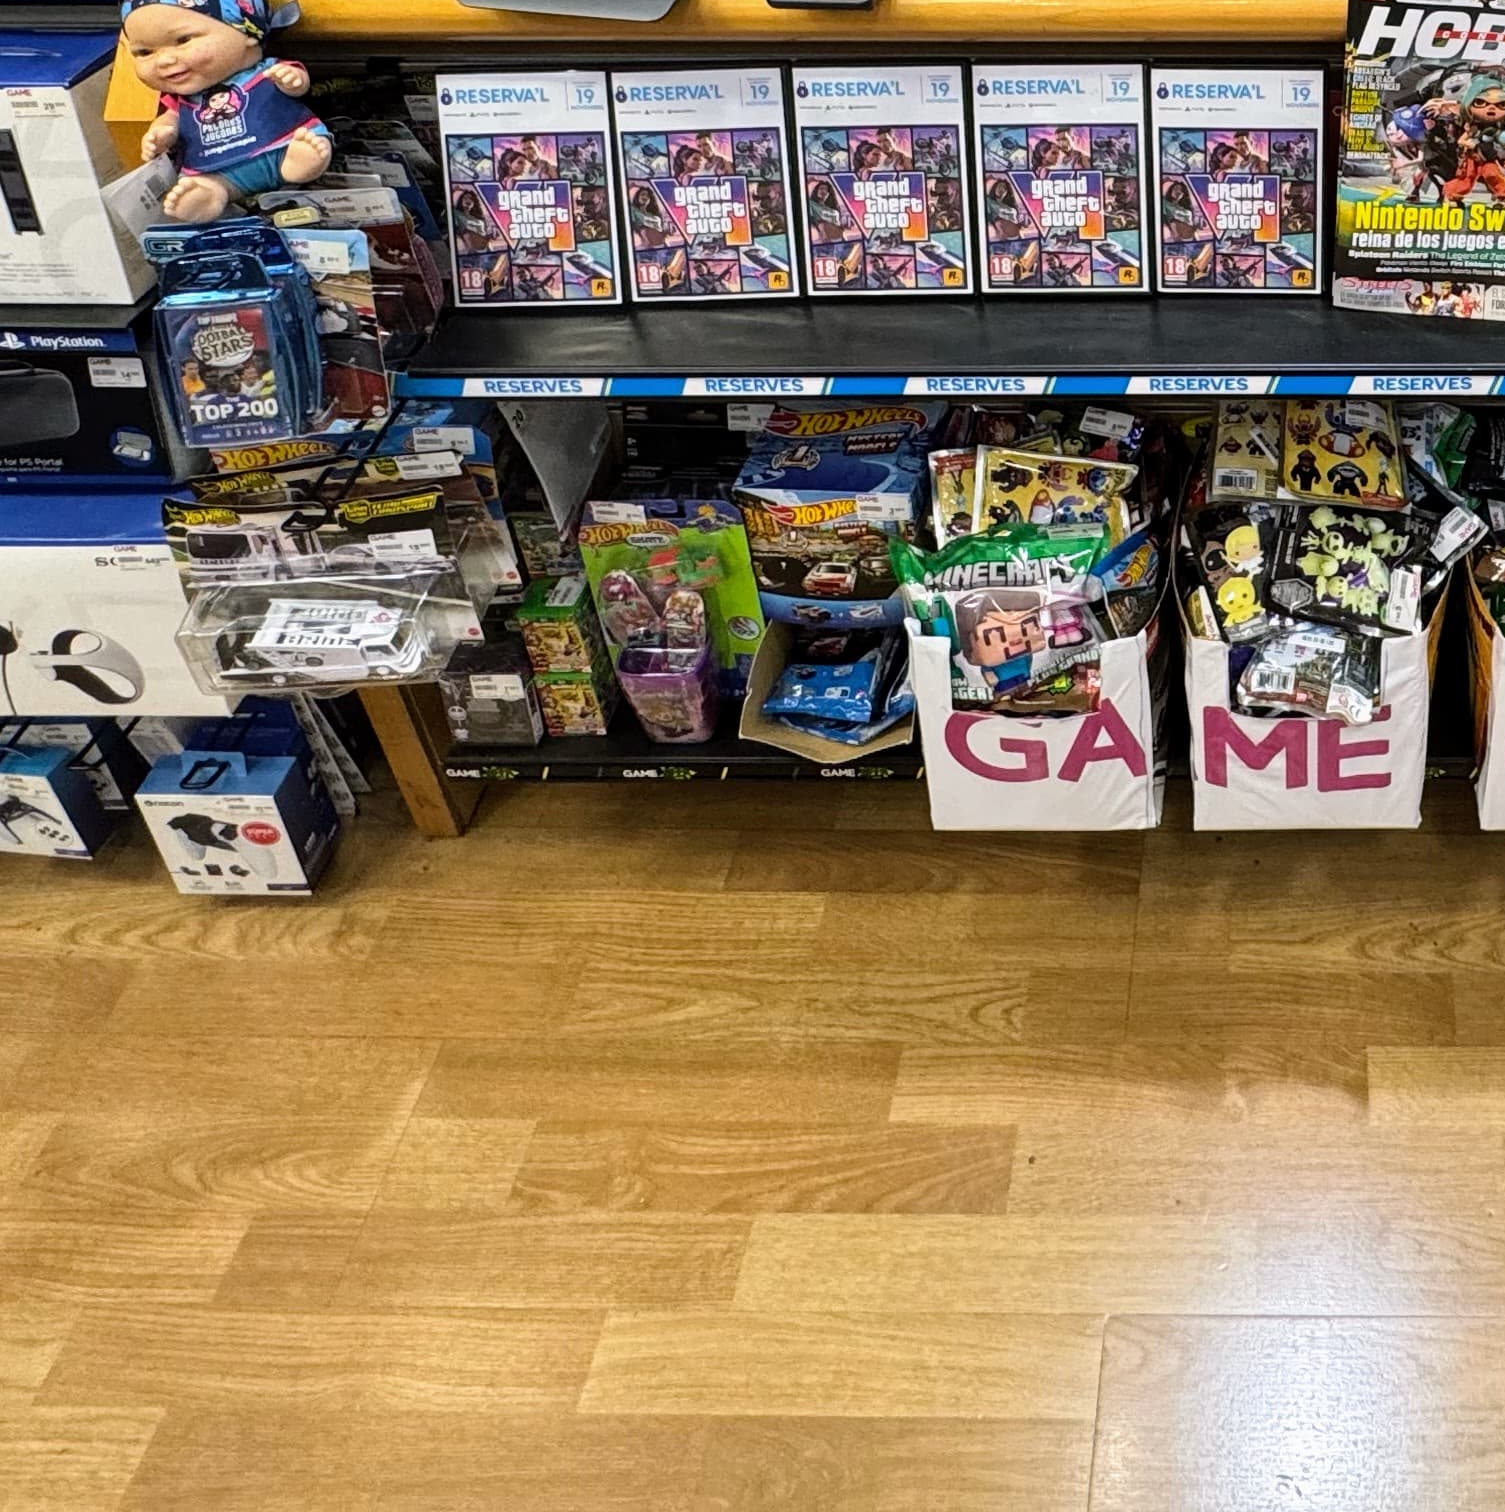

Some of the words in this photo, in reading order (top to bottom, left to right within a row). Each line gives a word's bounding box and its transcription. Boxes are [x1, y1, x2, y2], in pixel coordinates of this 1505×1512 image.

[455, 86, 549, 104] RESERVA'L
[576, 88, 594, 104] 19
[498, 186, 555, 210] grand
[510, 205, 569, 223] theft
[1355, 201, 1463, 232] Nintendo
[509, 222, 555, 239] auto
[1351, 232, 1391, 248] reina
[1394, 233, 1414, 248] de
[1416, 233, 1440, 249] los
[1442, 234, 1494, 252] juegos
[30, 335, 104, 349] PlayStation
[484, 380, 582, 393] RESERVES
[705, 379, 804, 392] RESERVES
[926, 378, 1025, 392] RESERVES
[1149, 378, 1248, 391] RESERVES
[191, 403, 236, 421] TOP
[240, 398, 278, 417] 200
[791, 410, 846, 434] HOT
[846, 406, 920, 429] WHEELS
